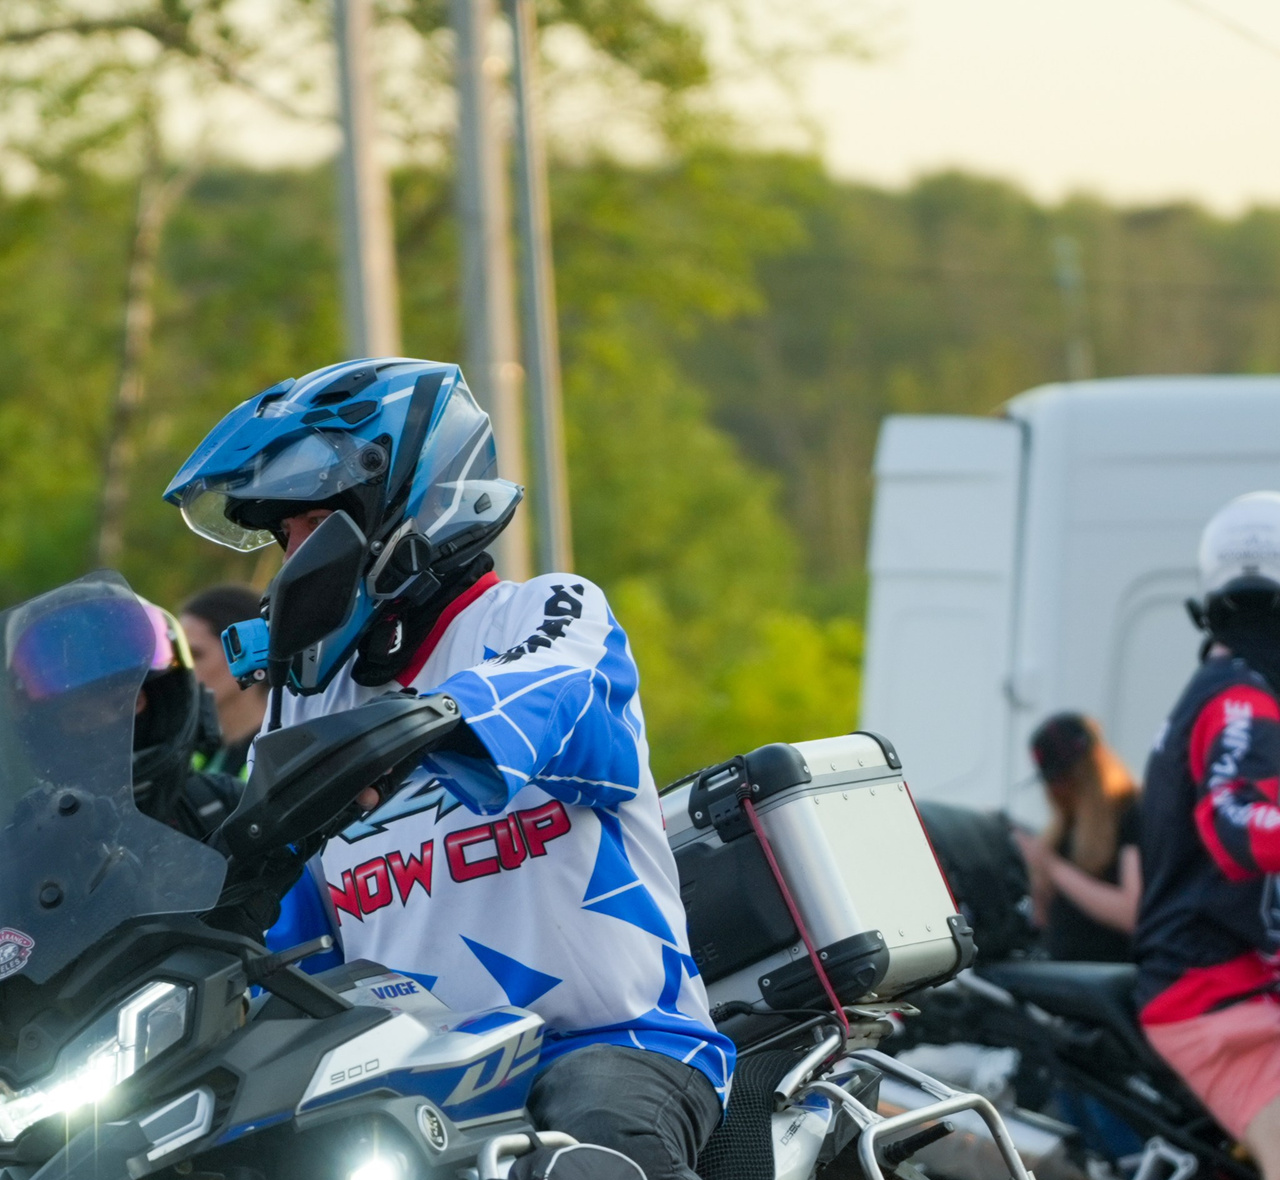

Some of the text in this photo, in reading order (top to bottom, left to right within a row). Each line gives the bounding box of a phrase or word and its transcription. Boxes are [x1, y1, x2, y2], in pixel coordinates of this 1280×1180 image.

[443, 799, 572, 884] CUP
[371, 980, 420, 1000] VOGE
[330, 1058, 380, 1085] 900
